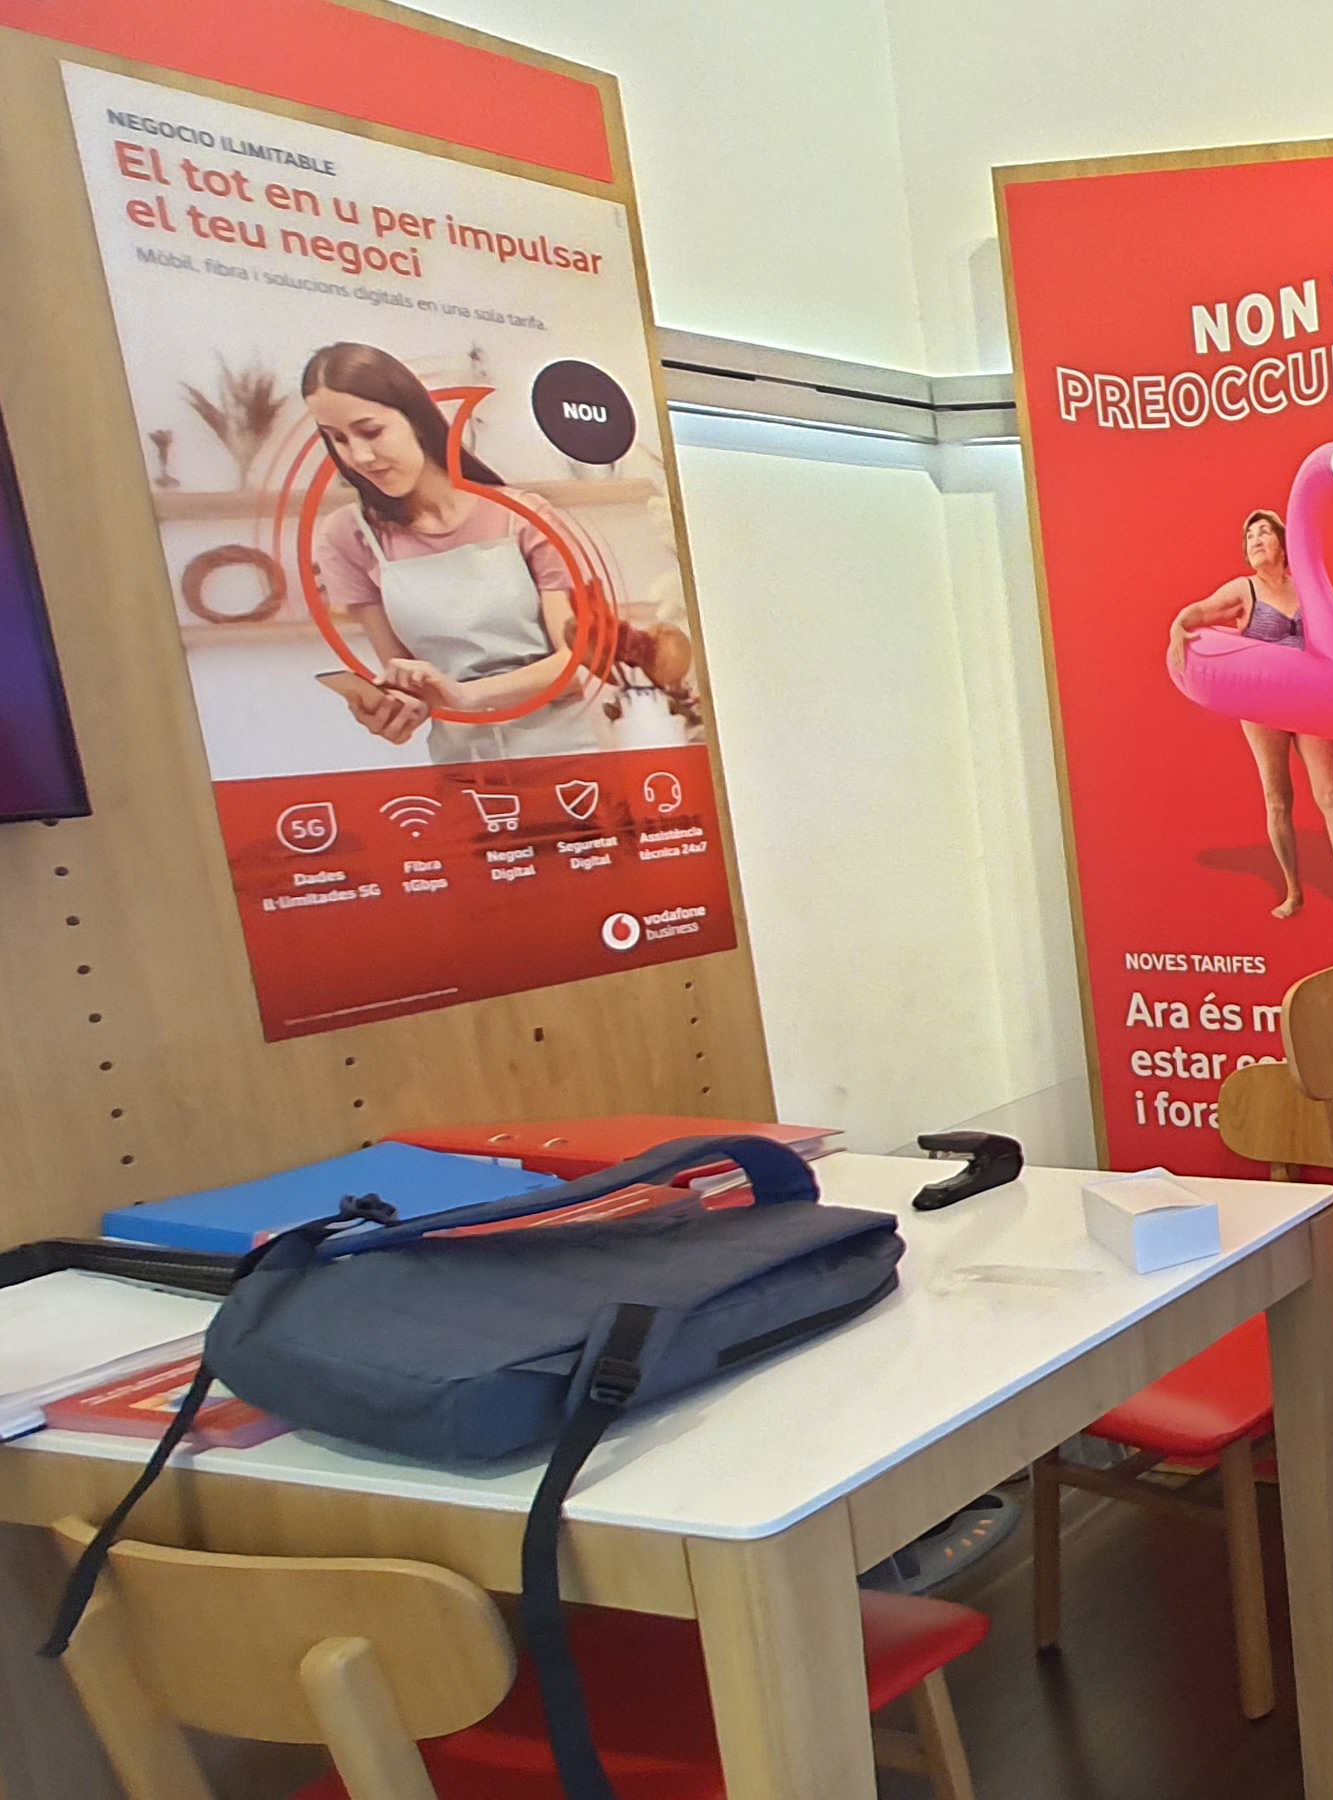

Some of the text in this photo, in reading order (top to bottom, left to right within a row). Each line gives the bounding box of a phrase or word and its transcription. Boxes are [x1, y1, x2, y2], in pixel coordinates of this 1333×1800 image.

[106, 108, 337, 176] NEGOCIO ILIMITABLE
[114, 139, 171, 186] El
[180, 158, 254, 203] tot
[265, 182, 321, 217] en
[333, 197, 360, 225] u
[372, 205, 436, 240] per
[445, 214, 602, 274] impulsar
[126, 195, 422, 278] el teu negoci
[204, 258, 249, 281] fibra
[263, 271, 349, 298] solucions
[353, 286, 414, 309] digitals
[417, 300, 438, 313] en
[442, 303, 471, 319] una
[473, 307, 505, 324] sola
[1191, 279, 1319, 354] NON
[561, 401, 608, 423] NOU
[290, 818, 326, 839] 5G
[486, 846, 535, 864] Negoci
[556, 836, 619, 854] Seguretat
[403, 860, 443, 874] Fibra
[569, 854, 613, 870] Digital
[293, 870, 347, 887] Dades
[490, 865, 537, 882] Digital
[357, 883, 382, 898] 5G
[643, 905, 707, 926] vodafone
[645, 921, 700, 941] business
[1125, 952, 1267, 975] NOVES TARIFES
[1125, 991, 1190, 1030] Ara
[1199, 991, 1244, 1032] és
[1130, 1045, 1227, 1080] estar
[1135, 1090, 1220, 1130] i fora
